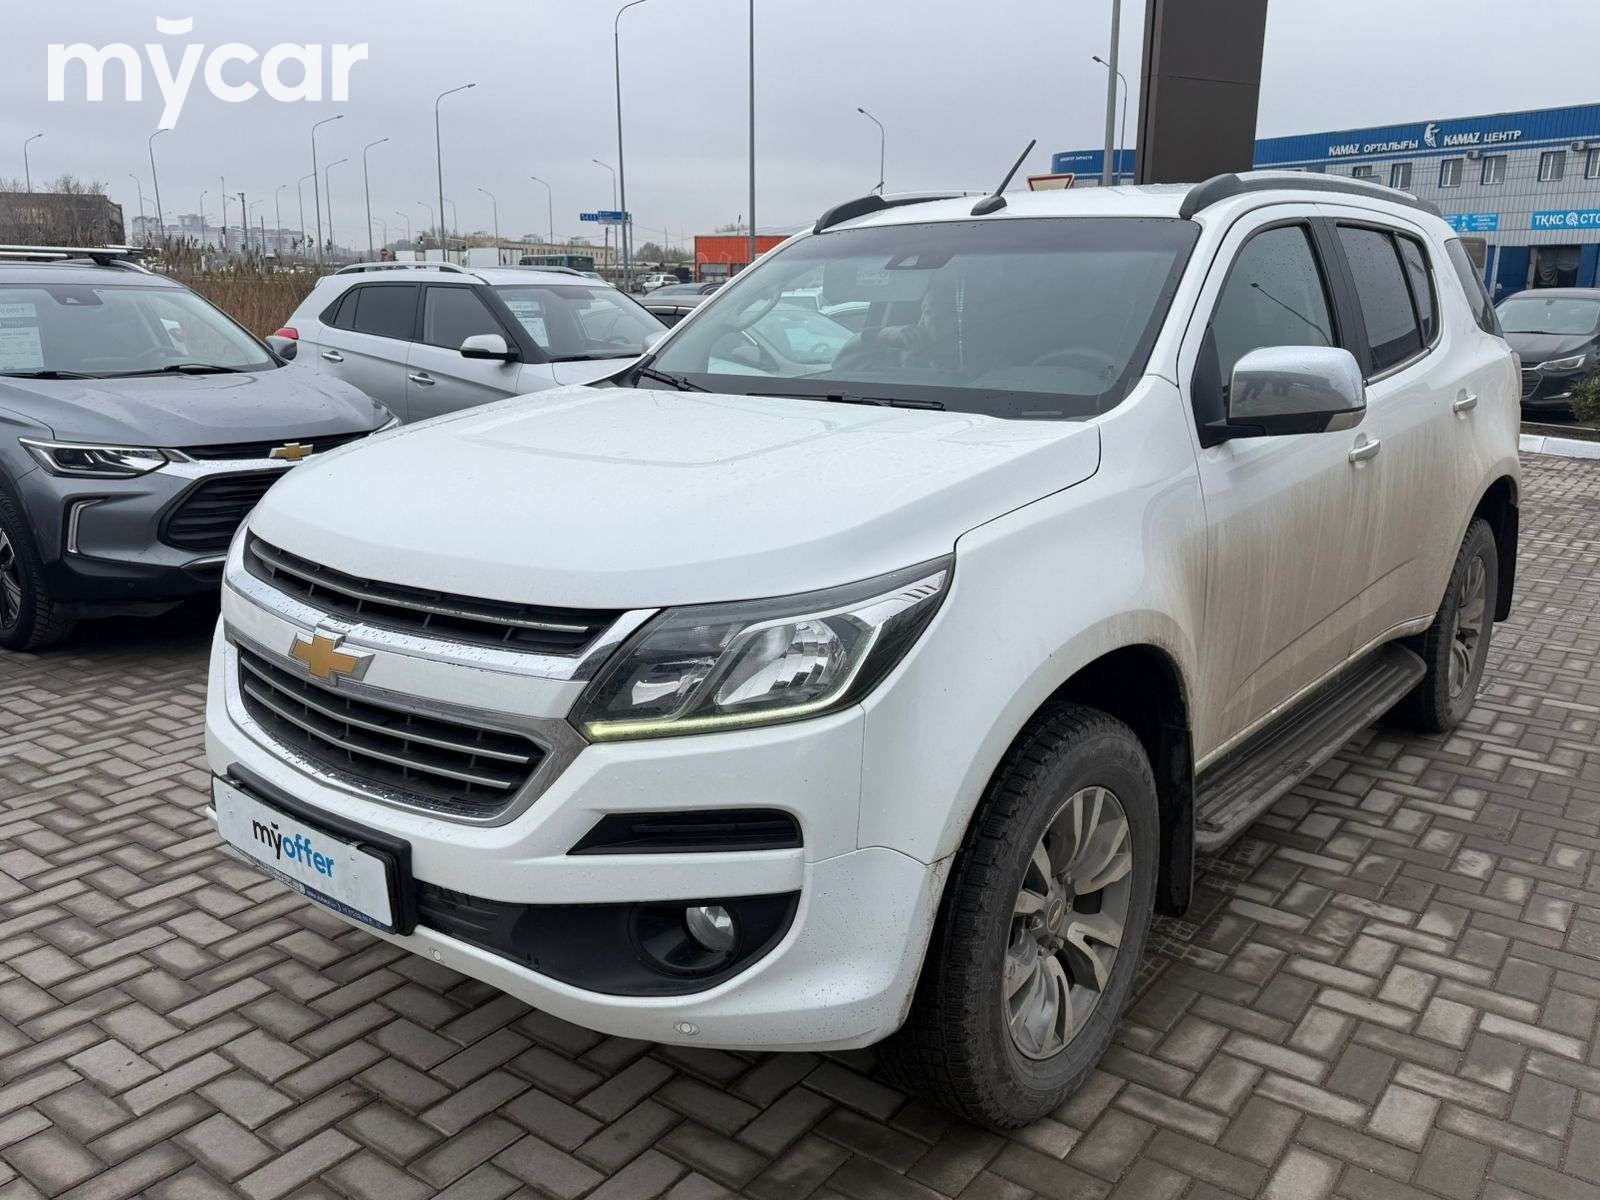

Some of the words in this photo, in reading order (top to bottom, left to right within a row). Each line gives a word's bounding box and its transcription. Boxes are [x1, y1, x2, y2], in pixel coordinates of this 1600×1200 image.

[1328, 144, 1360, 156] KAMAZ
[1443, 132, 1481, 146] KAMAZ
[1483, 130, 1522, 144] ЦЕНТР
